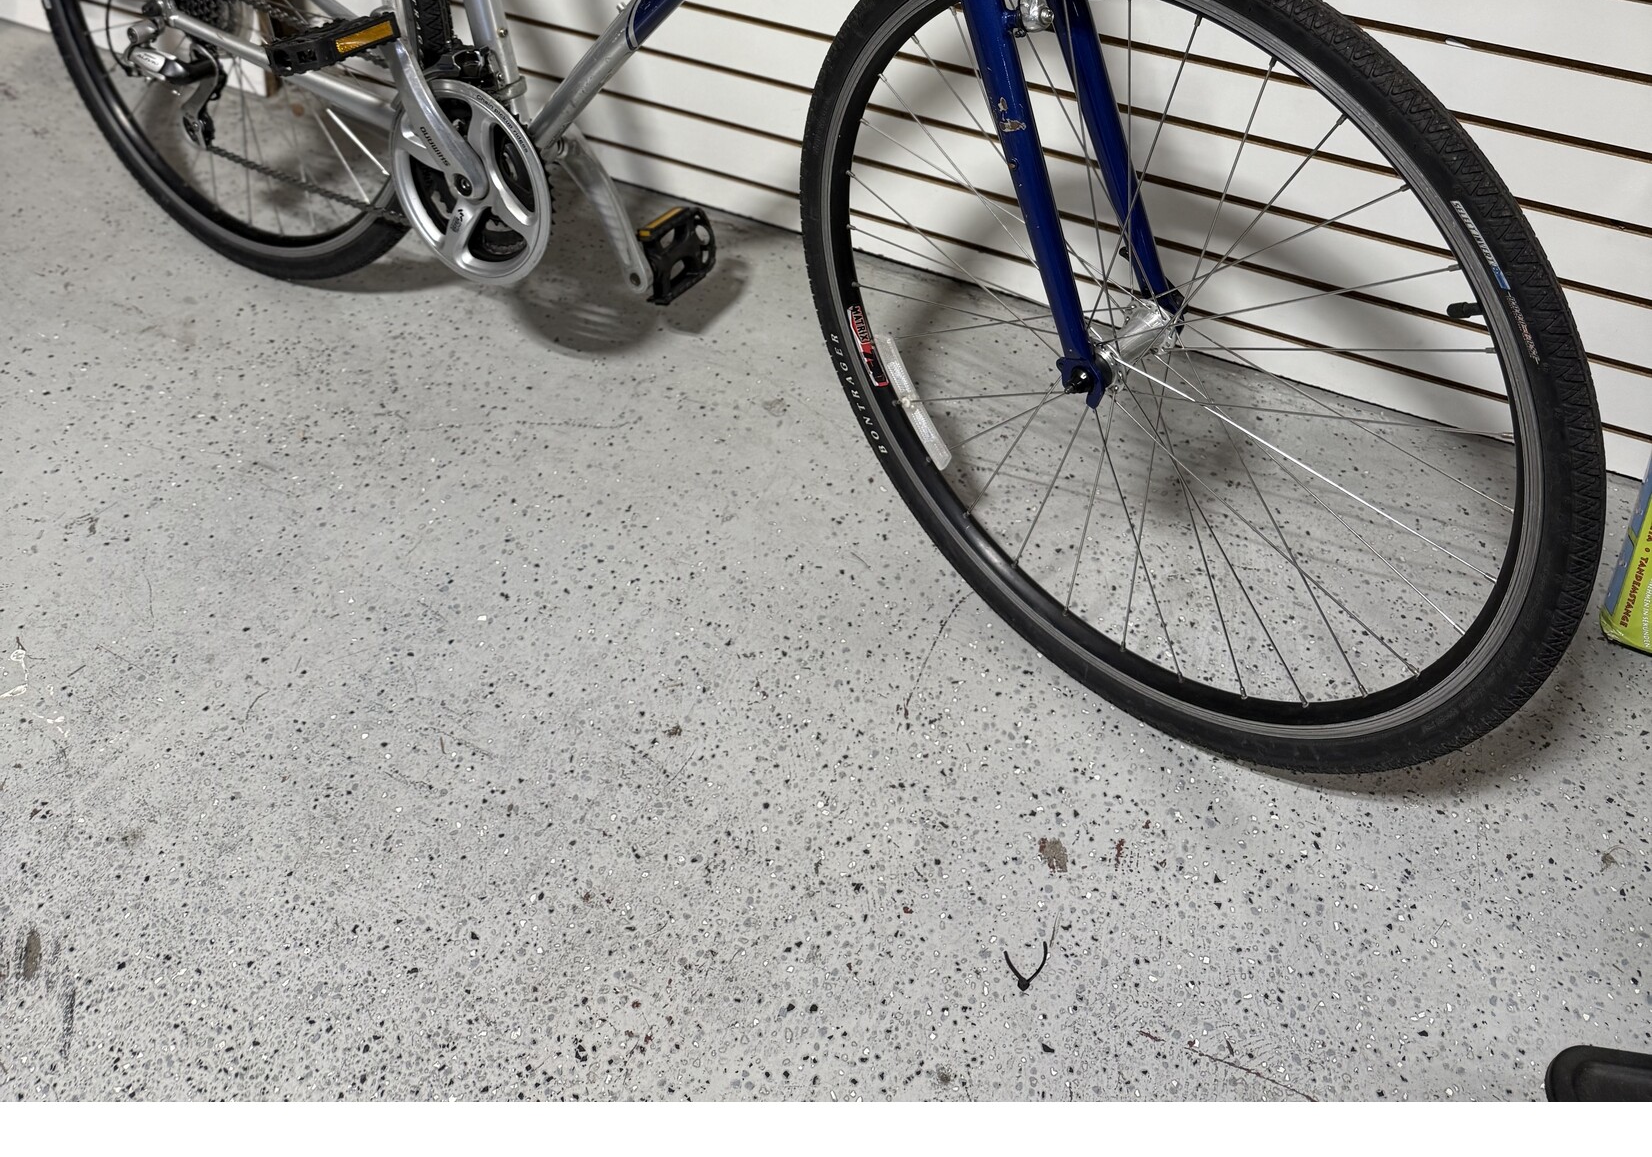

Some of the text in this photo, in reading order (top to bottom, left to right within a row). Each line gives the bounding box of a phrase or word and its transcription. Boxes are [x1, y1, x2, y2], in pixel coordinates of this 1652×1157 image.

[476, 94, 494, 110] Chain
[494, 108, 513, 129] pickup
[420, 126, 451, 166] SHIMANO
[852, 305, 871, 343] MATRIX
[830, 333, 888, 454] BONTRAGER
[1619, 556, 1649, 628] TANDEMSTANGE
[1642, 612, 1651, 648] SEKUNDEN
